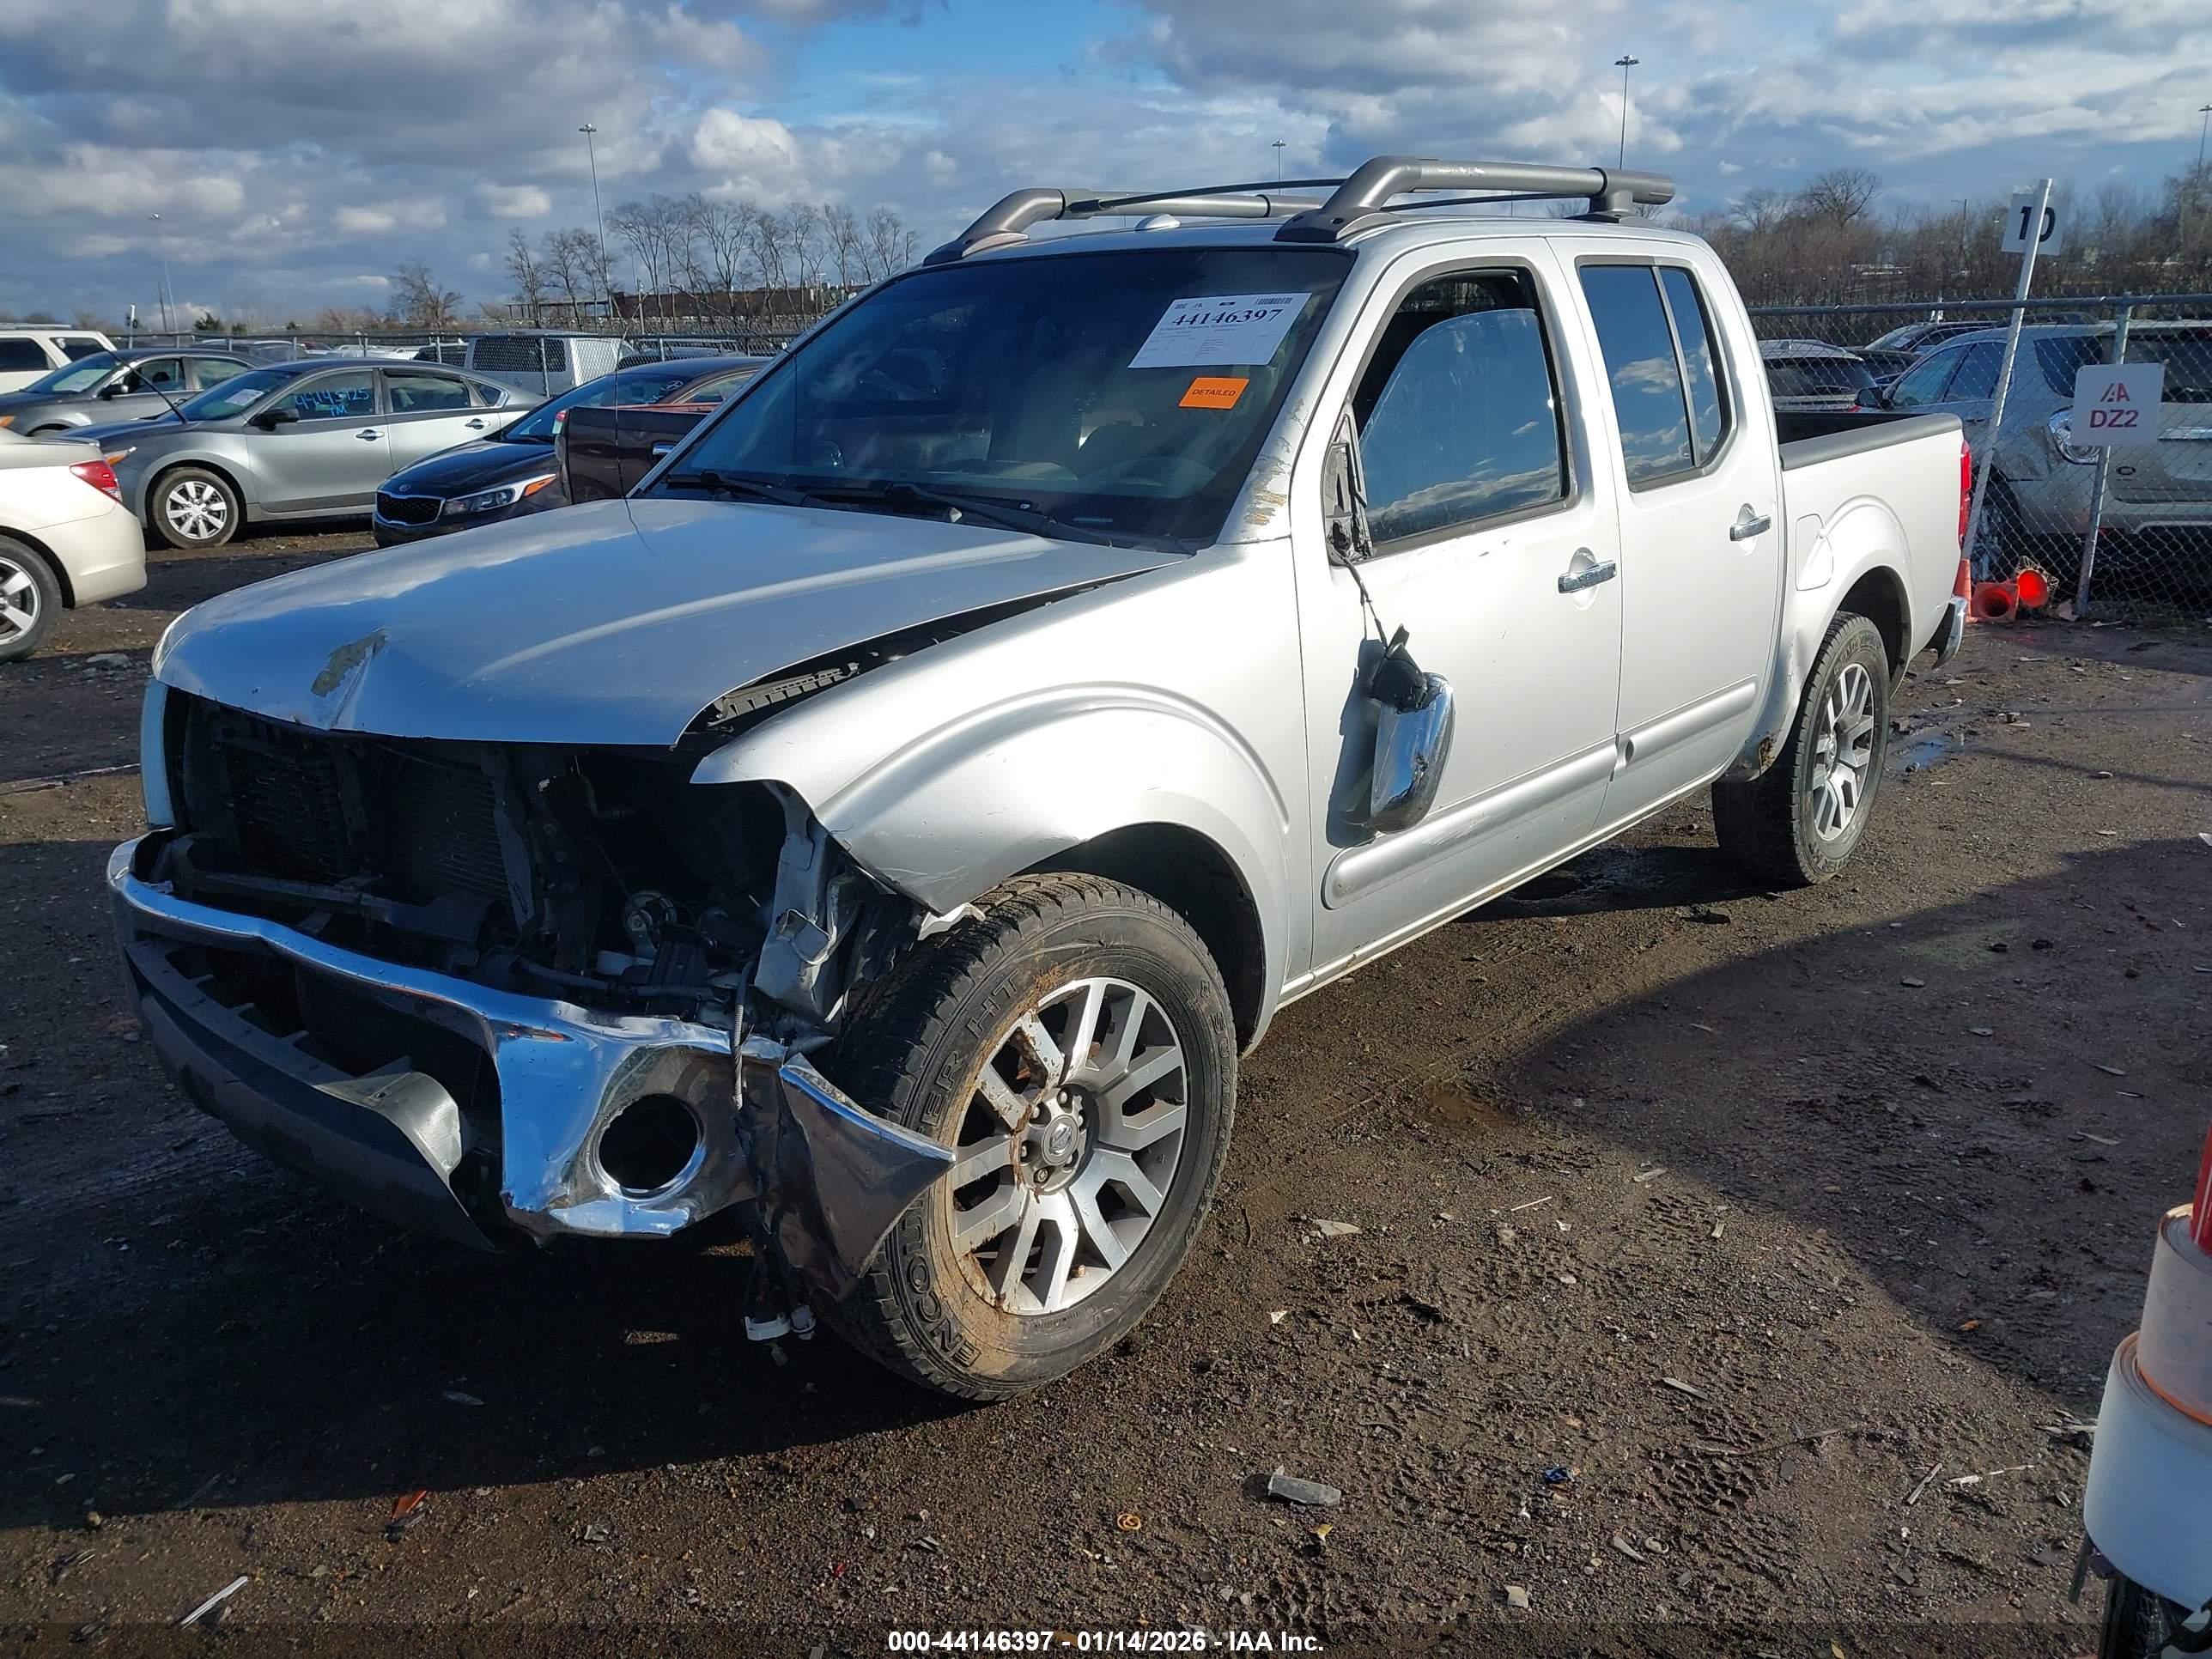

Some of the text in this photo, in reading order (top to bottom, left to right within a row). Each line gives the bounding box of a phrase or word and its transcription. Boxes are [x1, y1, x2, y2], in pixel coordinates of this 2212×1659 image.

[1172, 308, 1284, 326] 44146397
[1192, 388, 1237, 397] DETAILED
[2090, 409, 2139, 428] DZ2
[965, 968, 1019, 1039] HT
